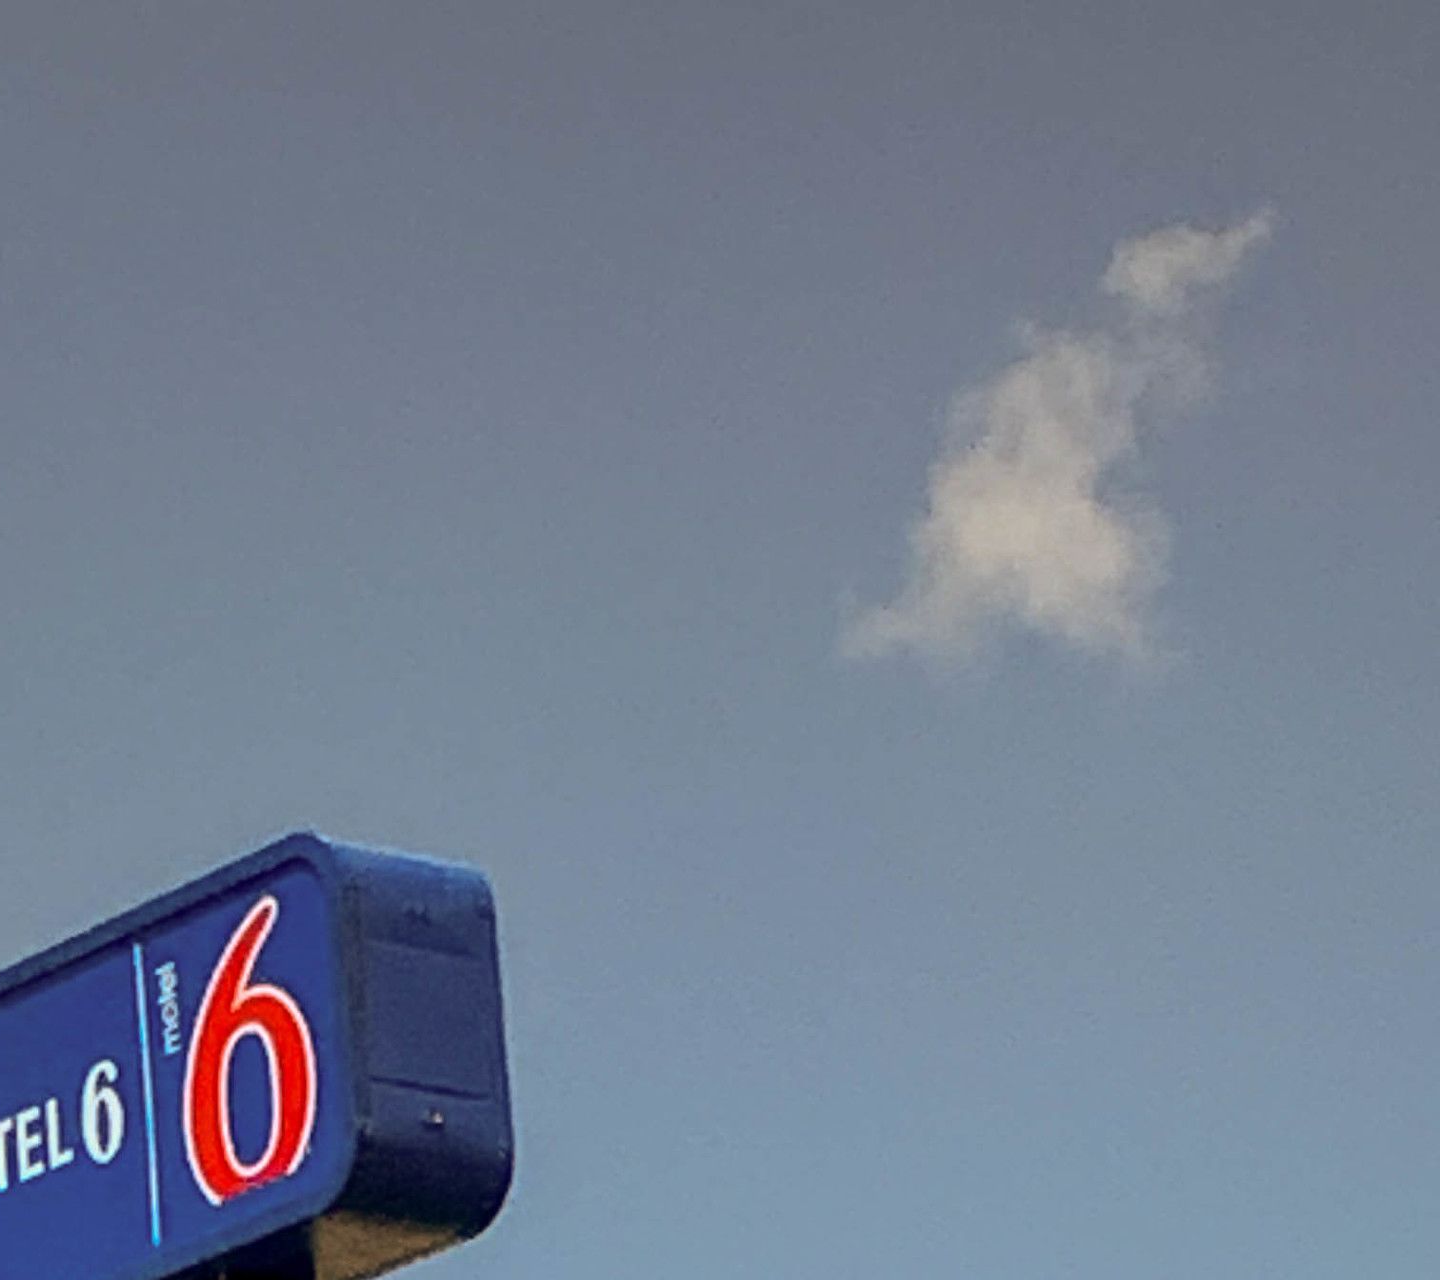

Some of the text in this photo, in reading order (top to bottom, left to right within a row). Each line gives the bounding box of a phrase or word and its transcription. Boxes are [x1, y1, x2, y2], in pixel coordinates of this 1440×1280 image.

[81, 1059, 125, 1164] 6
[154, 895, 317, 1206] motel 6
